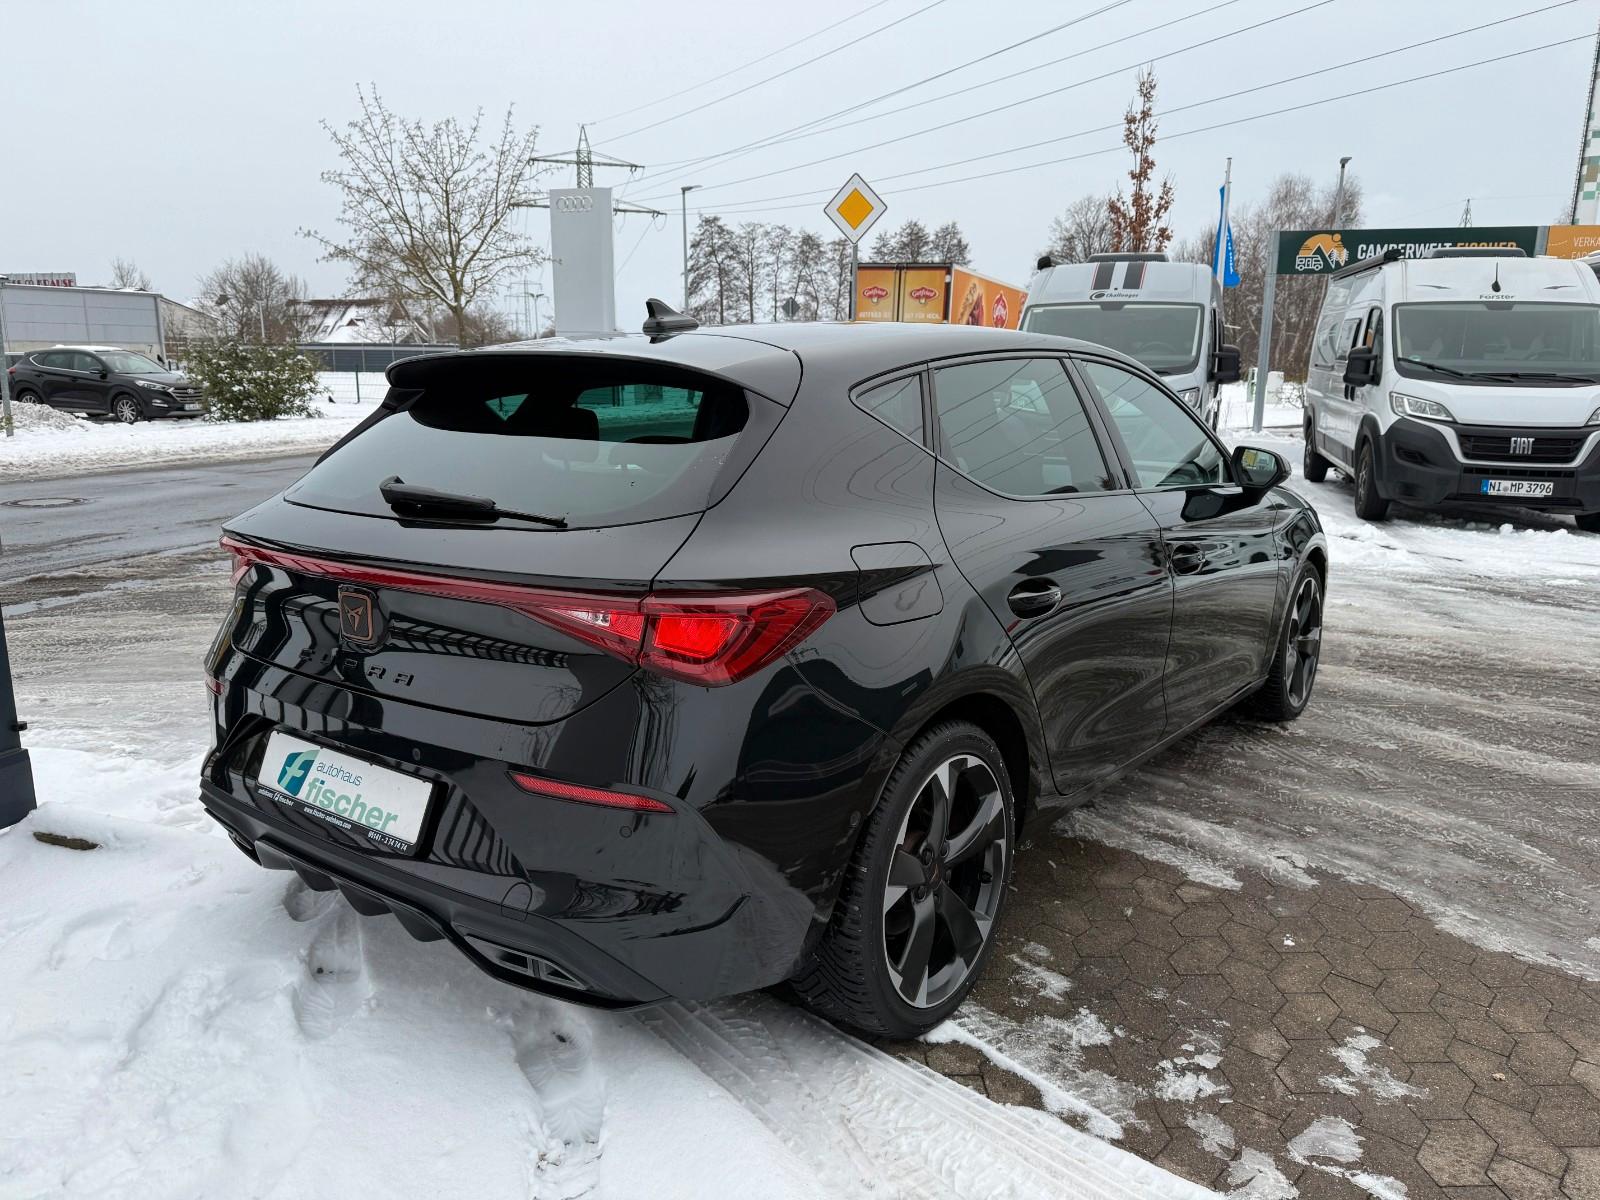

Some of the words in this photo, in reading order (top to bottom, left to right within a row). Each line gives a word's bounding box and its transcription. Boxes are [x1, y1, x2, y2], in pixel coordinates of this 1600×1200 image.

[1510, 437, 1535, 455] FIAT
[1488, 481, 1502, 492] NI
[1510, 482, 1524, 493] MP
[1525, 483, 1552, 495] 3796
[316, 761, 363, 786] autohaus
[304, 777, 399, 831] fischer
